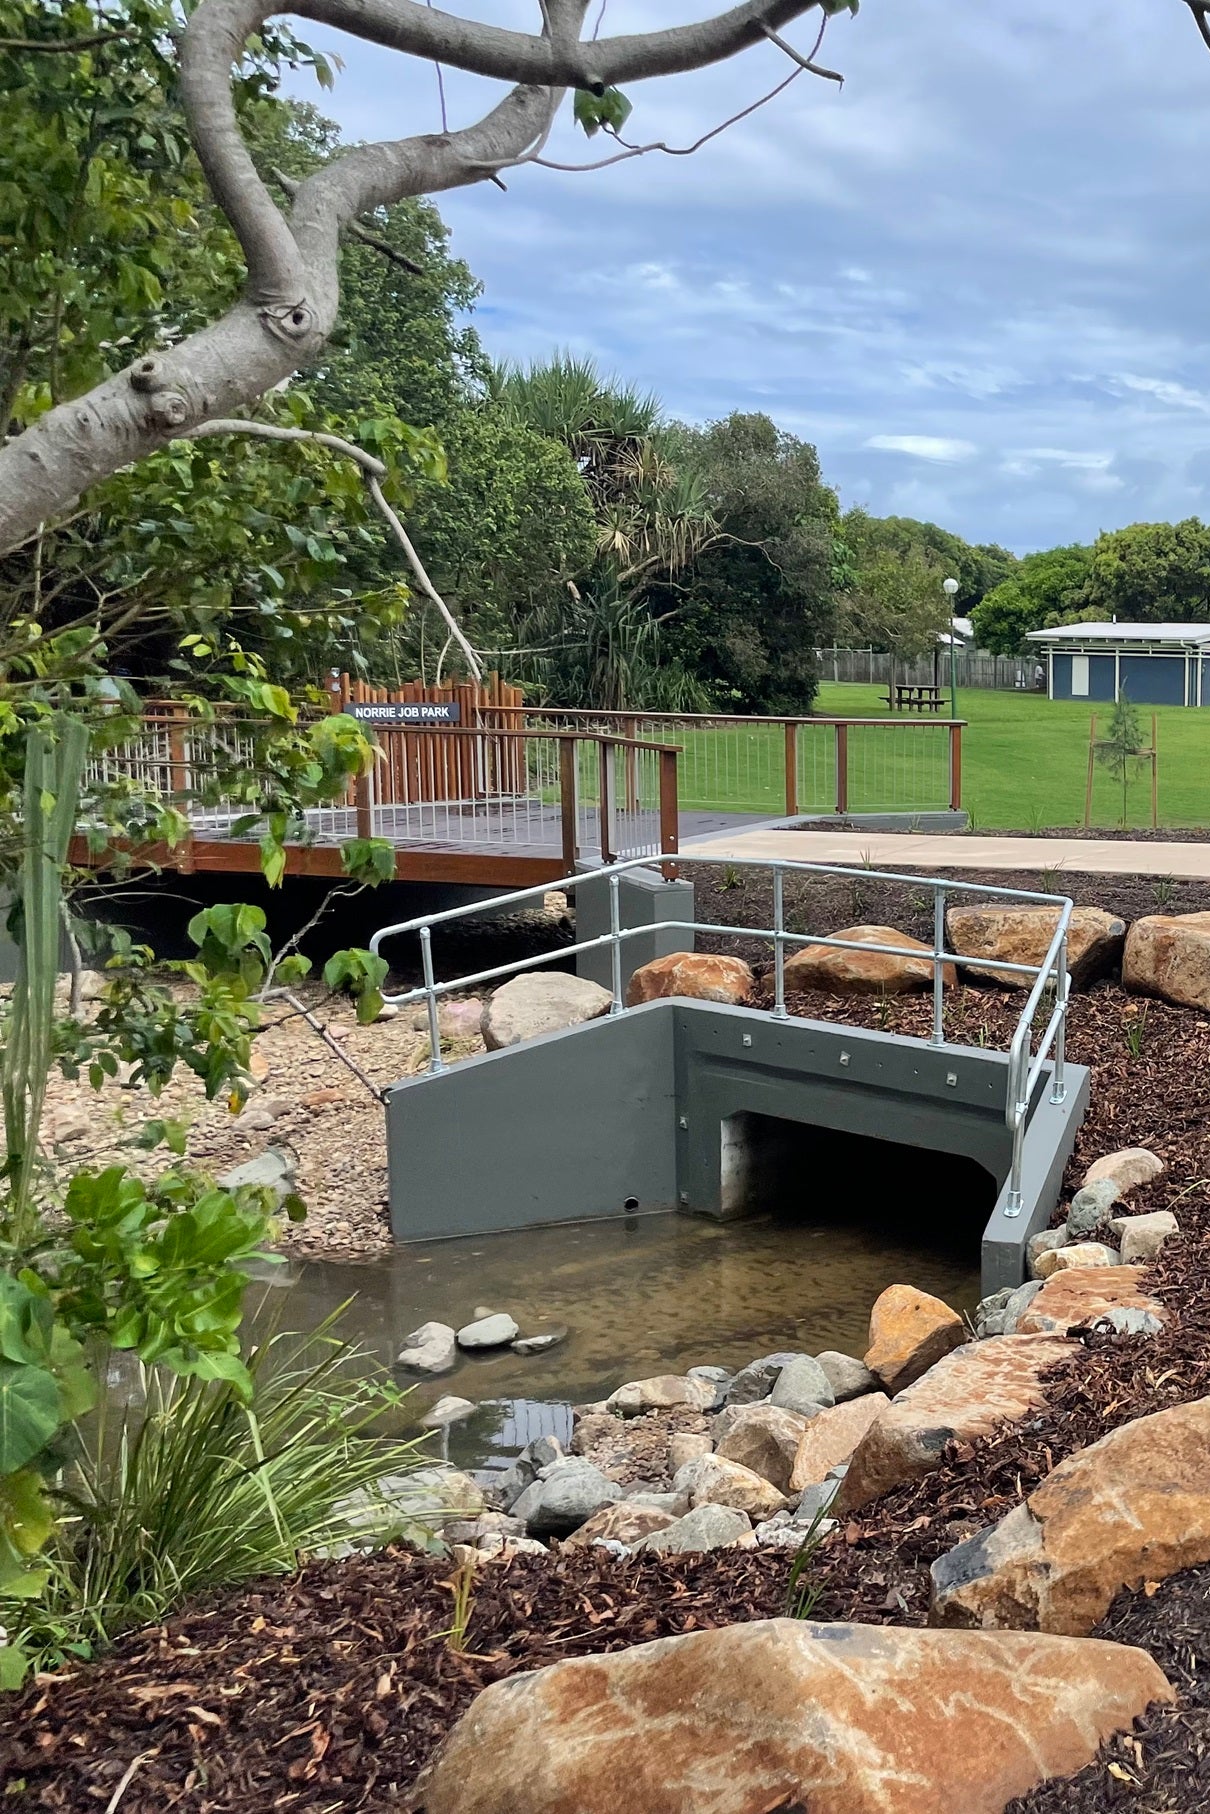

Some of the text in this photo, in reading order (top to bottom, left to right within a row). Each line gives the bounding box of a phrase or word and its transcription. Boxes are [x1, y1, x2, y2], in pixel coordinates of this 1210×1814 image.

[355, 707, 450, 718] NORRIE JOB PARK
